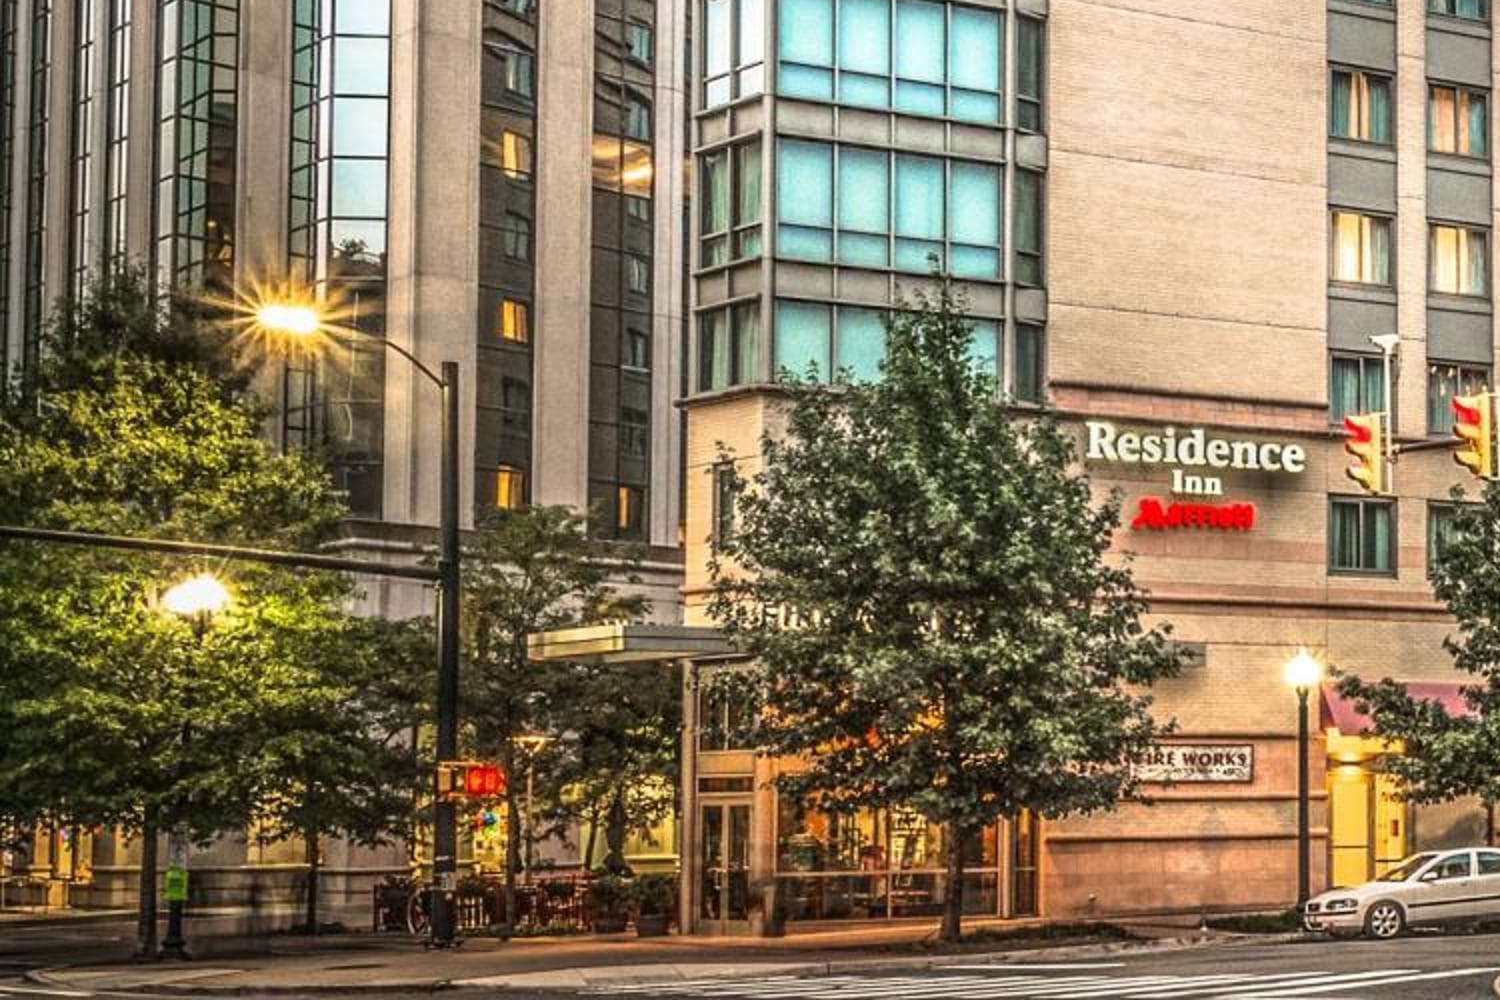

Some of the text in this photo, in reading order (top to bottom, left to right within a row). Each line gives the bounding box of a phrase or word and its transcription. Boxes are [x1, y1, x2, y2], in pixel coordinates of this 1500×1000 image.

[1086, 421, 1306, 473] Residence
[1171, 469, 1223, 495] Inn
[1136, 751, 1247, 767] IRE WORKS
